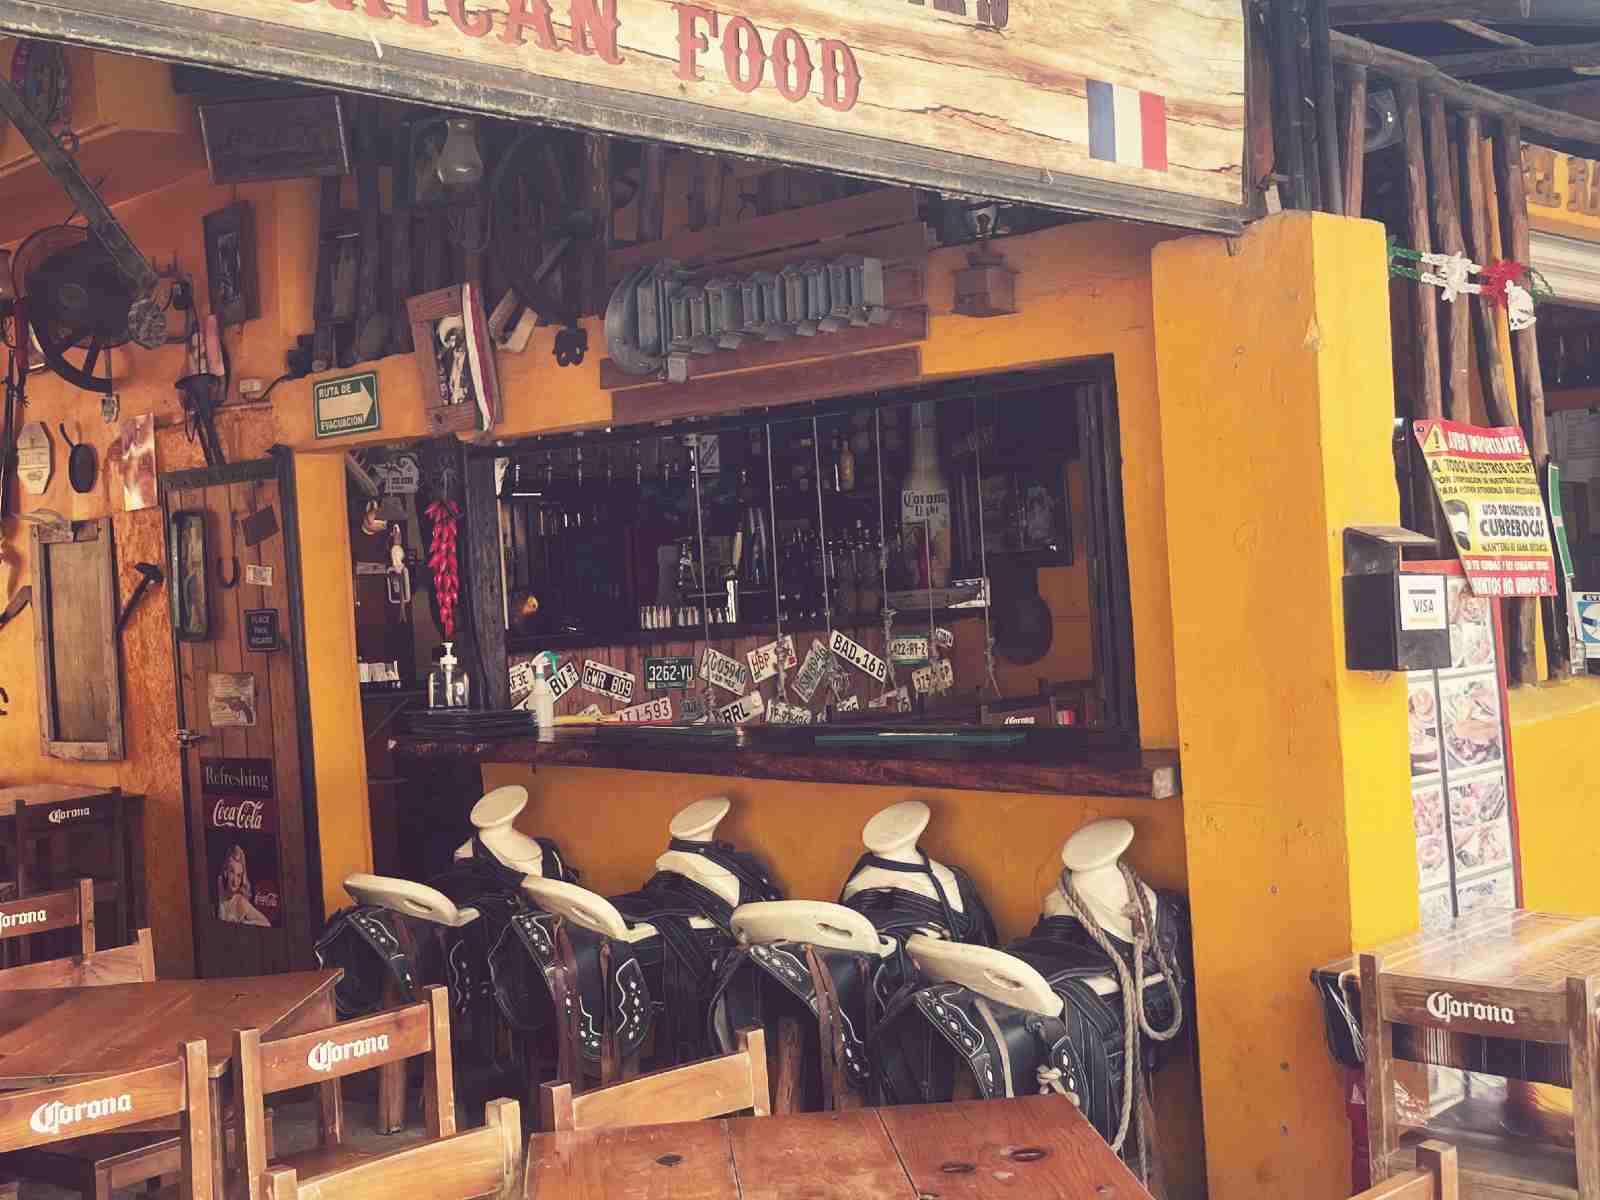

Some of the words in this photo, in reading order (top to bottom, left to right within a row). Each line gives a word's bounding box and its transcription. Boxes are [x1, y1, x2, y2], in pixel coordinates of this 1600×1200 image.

[670, 2, 864, 112] FOOD
[318, 385, 338, 400] RUTA
[341, 383, 352, 393] DE
[1469, 461, 1507, 474] NUESTROS
[1482, 504, 1496, 516] USO
[1480, 518, 1545, 538] CUBREBOCAS
[1413, 598, 1434, 612] VISA
[649, 664, 694, 681] 3262-YU
[611, 673, 634, 697] 809
[206, 766, 269, 791] Refreshing
[48, 806, 91, 824] Corona
[1426, 991, 1516, 1025] Corona
[307, 1033, 390, 1072] Corona
[29, 1093, 132, 1134] Corona
